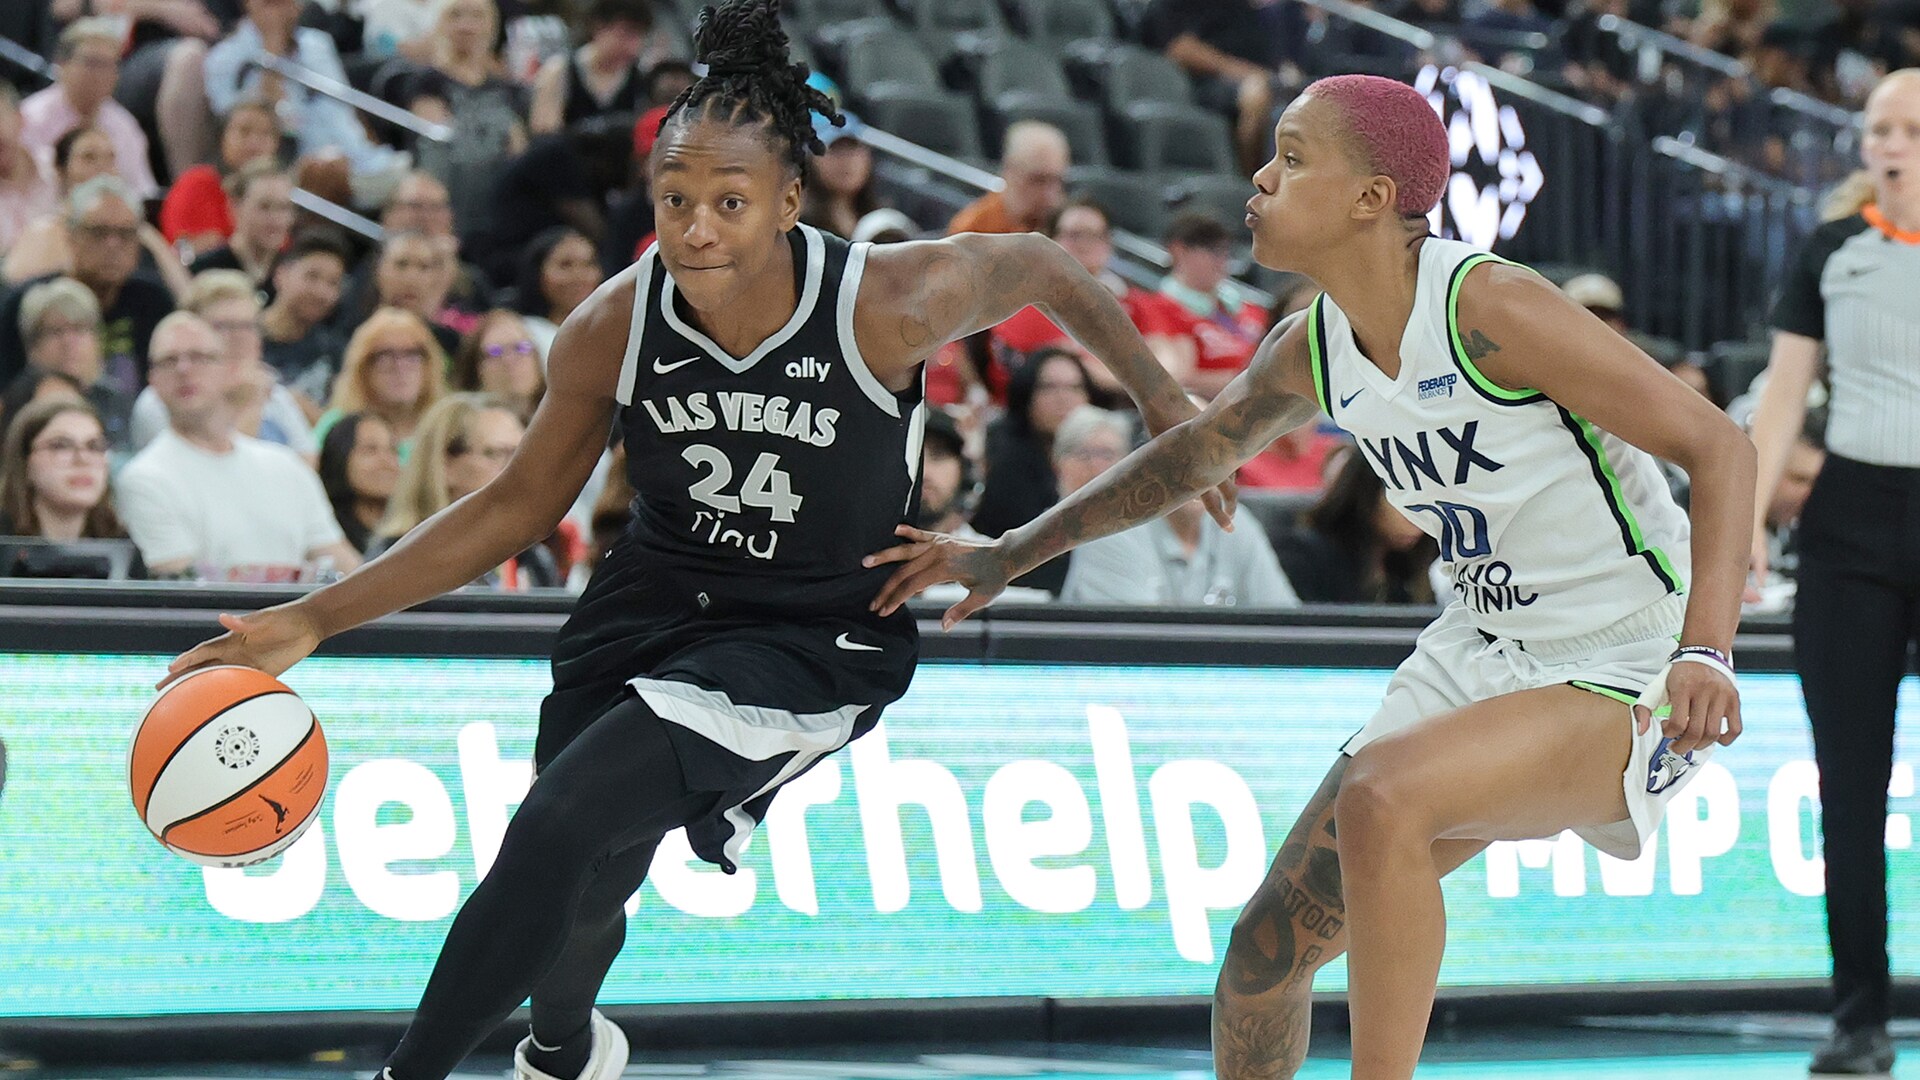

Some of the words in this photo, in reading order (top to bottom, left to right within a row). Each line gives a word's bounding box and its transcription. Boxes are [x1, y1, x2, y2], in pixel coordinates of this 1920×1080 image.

[785, 357, 831, 382] ally
[1418, 373, 1457, 392] FEDERATED
[642, 392, 717, 433] LAS
[716, 391, 841, 447] VEGAS
[681, 443, 803, 523] 24
[1363, 420, 1505, 490] YNX
[1453, 561, 1512, 586] AYO
[202, 704, 1267, 964] eterhelp
